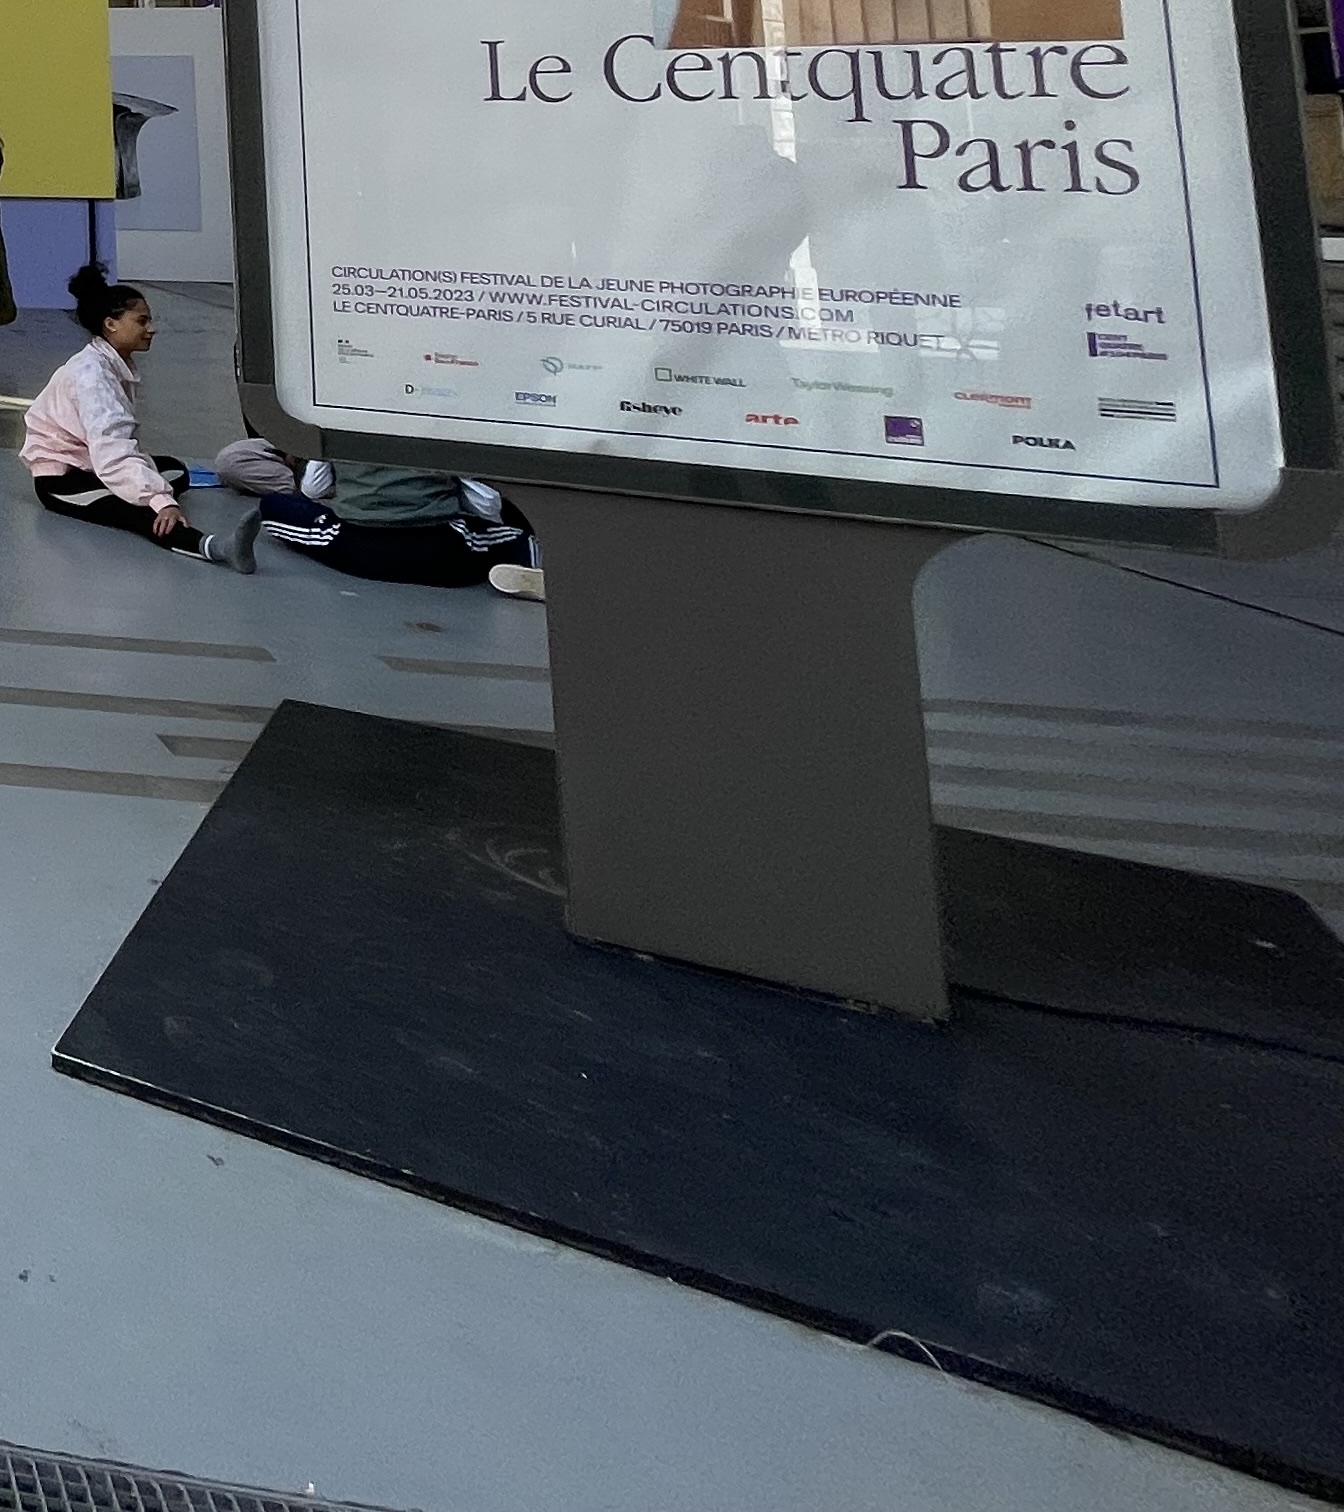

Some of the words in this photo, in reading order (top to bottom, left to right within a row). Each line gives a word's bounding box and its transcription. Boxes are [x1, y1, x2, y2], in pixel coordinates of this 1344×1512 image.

[479, 39, 574, 103] Le
[602, 34, 1132, 123] Centquatre
[893, 118, 1142, 196] Paris
[331, 266, 458, 285] CIRCULATION(S)
[460, 271, 538, 288] FESTIVAL
[540, 275, 564, 289] DE
[567, 276, 592, 290] LA
[594, 277, 655, 294] JEUNE
[818, 287, 963, 309] EUROPÉENNE
[332, 300, 352, 314] LE
[354, 301, 514, 323] CENTQUATRE-PARIS
[526, 311, 538, 324] 5
[541, 313, 576, 326] RUE
[579, 314, 648, 331] CURIAL
[659, 319, 712, 335] 75019
[717, 321, 774, 338] PARIS
[867, 330, 946, 352] RIQUET
[745, 413, 799, 426] arte
[1012, 434, 1076, 451] POLKA
